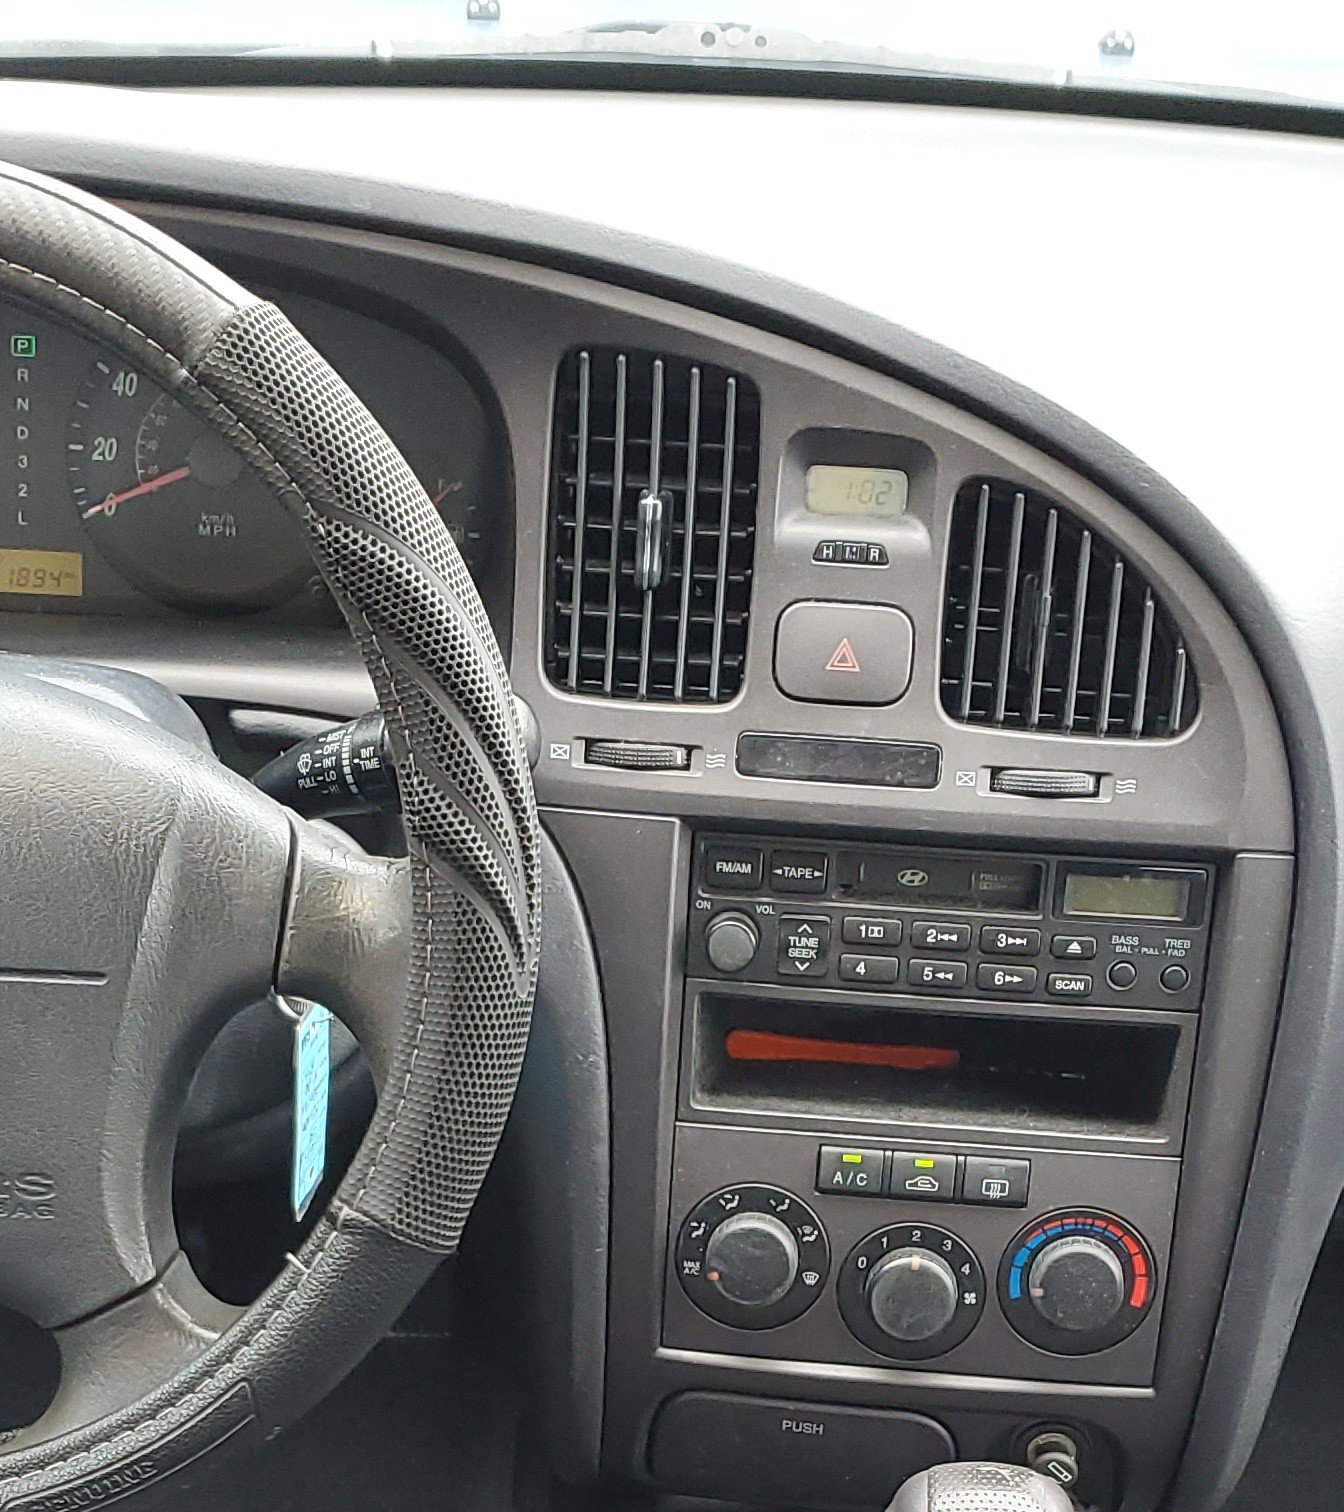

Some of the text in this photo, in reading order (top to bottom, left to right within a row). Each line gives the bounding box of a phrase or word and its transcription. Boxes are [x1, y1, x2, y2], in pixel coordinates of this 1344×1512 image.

[17, 340, 29, 353] P
[17, 368, 29, 382] R
[112, 371, 138, 397] 40
[17, 398, 29, 411] N
[17, 426, 29, 440] D
[91, 436, 118, 461] 20
[17, 455, 28, 468] 3
[18, 484, 28, 497] 2
[18, 510, 28, 525] L
[199, 525, 237, 537] MPH
[822, 545, 834, 560] H
[323, 742, 341, 755] OFF
[360, 746, 375, 758] INT
[322, 756, 337, 769] INT
[359, 758, 381, 771] TIME
[297, 770, 337, 790] PULL LO
[715, 861, 753, 875] FM/AM
[782, 866, 814, 879] TAPE
[695, 899, 712, 911] ON
[755, 904, 777, 915] VOL
[860, 925, 867, 938] 1
[926, 929, 937, 942] 2
[787, 936, 820, 948] TUNE
[997, 934, 1007, 947] 3
[1111, 934, 1140, 946] BASS
[1164, 938, 1192, 950] TREB
[787, 948, 818, 960] SEEK
[1115, 946, 1134, 954] BAL
[1167, 949, 1187, 957] FAD
[855, 961, 867, 975] 4
[922, 967, 934, 981] 5
[994, 972, 1005, 985] 6
[1054, 980, 1085, 991] SCAN
[833, 1172, 868, 1187] A/C
[881, 1236, 888, 1249] 1
[912, 1230, 922, 1242] 2
[942, 1239, 953, 1251] 3
[857, 1256, 868, 1270] 0
[960, 1262, 971, 1276] 4
[781, 1419, 824, 1436] PUSH
